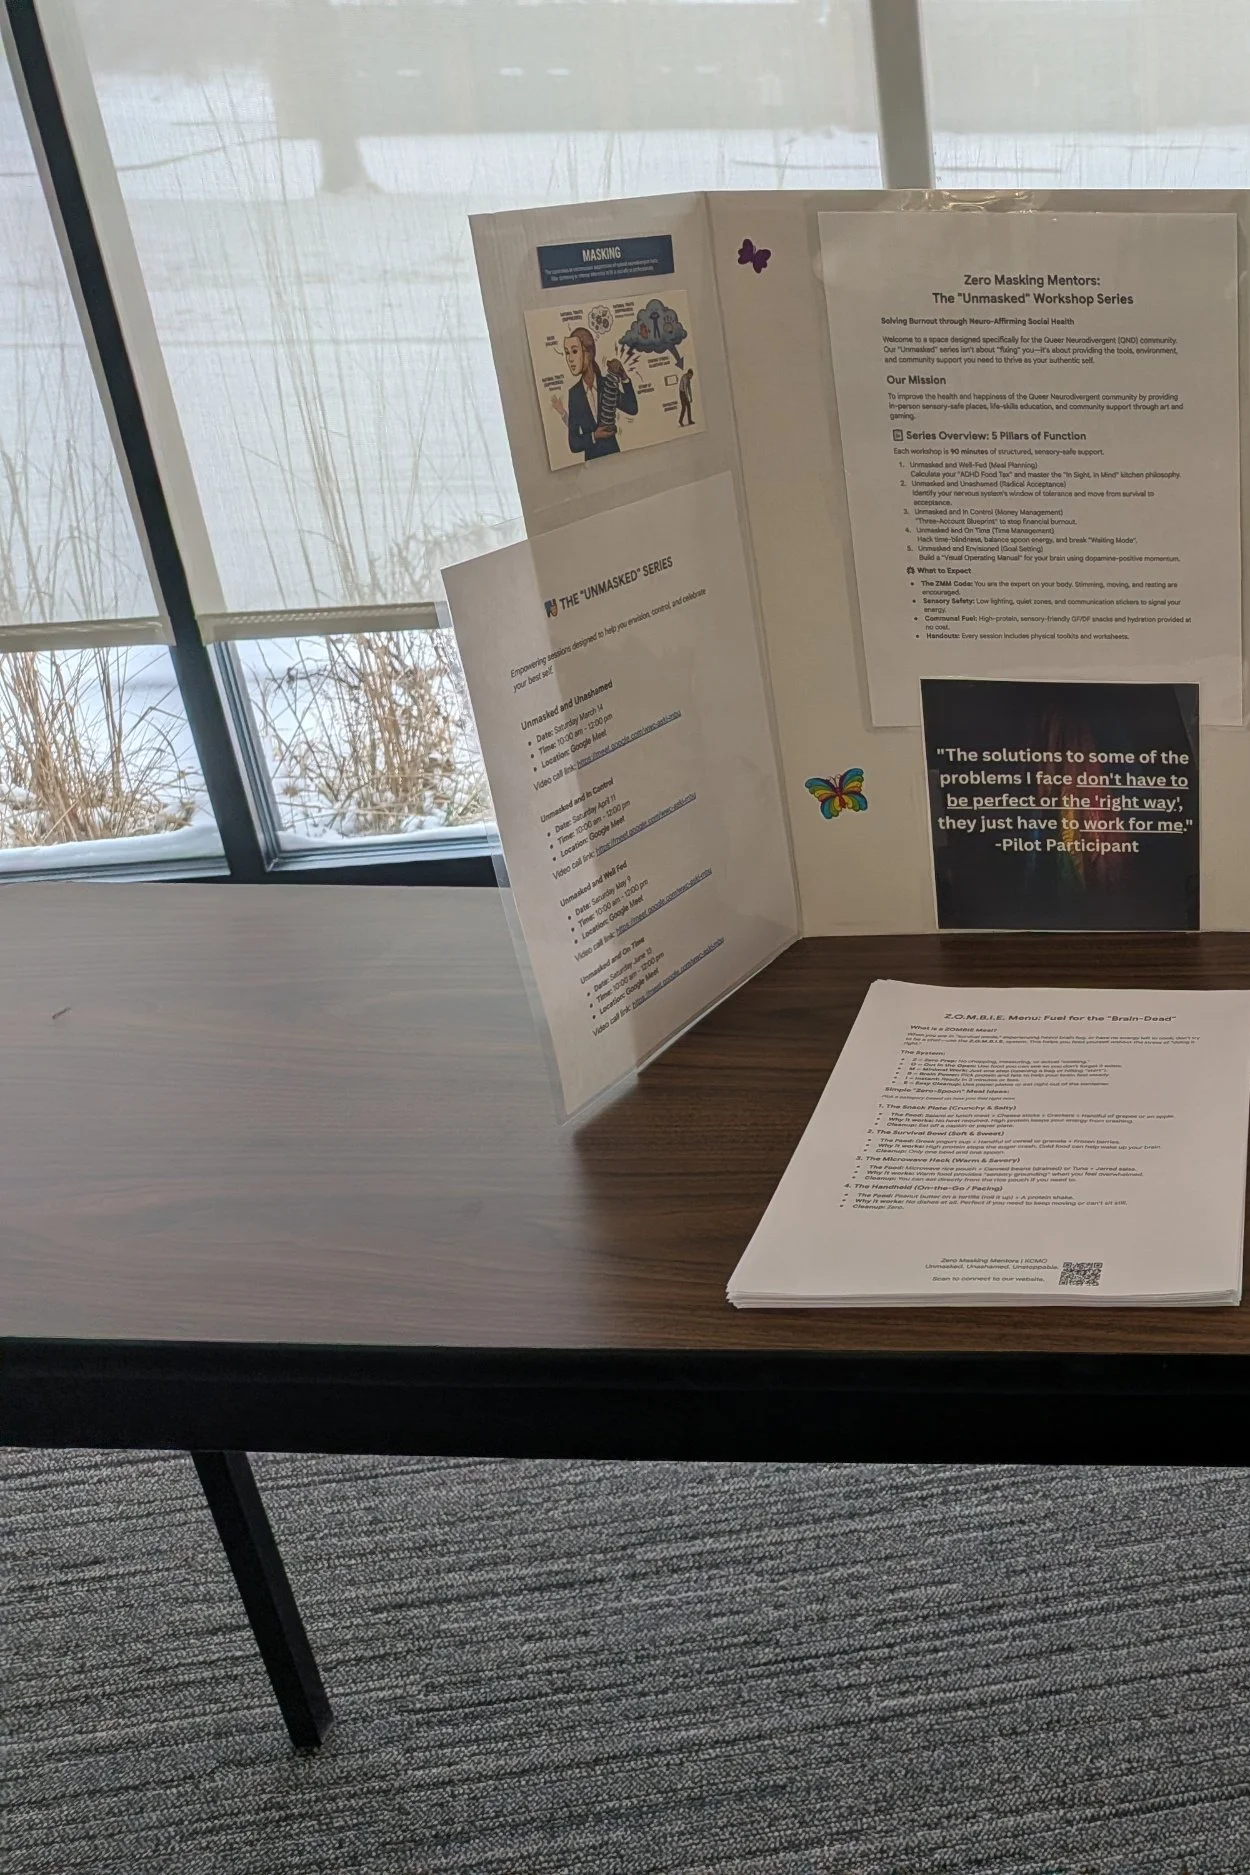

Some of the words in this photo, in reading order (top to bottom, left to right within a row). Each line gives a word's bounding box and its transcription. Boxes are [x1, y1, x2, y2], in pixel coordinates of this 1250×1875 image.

[582, 247, 621, 262] MASKING
[963, 274, 992, 286] Zero
[994, 273, 1045, 289] Masking
[1047, 274, 1101, 286] Mentors:
[931, 292, 955, 304] The
[957, 292, 1031, 304] "Unmasked"
[1032, 292, 1094, 307] Workshop
[1096, 292, 1134, 305] Series
[880, 316, 908, 326] Solving
[908, 317, 938, 325] Burnout
[938, 317, 968, 327] through
[968, 317, 1027, 327] Neuro-Affirming
[1027, 316, 1050, 325] Social
[1050, 317, 1075, 325] Health
[886, 374, 907, 385] Our
[907, 374, 947, 385] Mission
[906, 430, 937, 440] Series
[938, 430, 990, 441] Overview:
[991, 431, 998, 441] 5
[999, 431, 1030, 440] Pillars
[1030, 430, 1042, 441] of
[1043, 430, 1087, 441] Function
[916, 566, 937, 574] What
[946, 567, 972, 576] Expect
[558, 592, 580, 610] THE
[579, 567, 641, 600] "UNMASKED"
[642, 555, 673, 577] SERIES
[520, 704, 560, 731] Unmasked
[559, 697, 574, 713] and
[573, 679, 613, 705] Unashamed
[535, 729, 554, 744] Date:
[553, 716, 579, 735] Saturday
[578, 707, 597, 721] March
[596, 703, 604, 712] 14
[540, 748, 570, 769] Location:
[570, 737, 592, 754] Google
[591, 728, 608, 742] Meet
[937, 748, 977, 761] "The
[983, 748, 1061, 762] solutions
[1066, 750, 1084, 762] to
[1089, 752, 1134, 763] some
[1140, 750, 1156, 764] of
[1161, 750, 1189, 764] the
[940, 770, 1021, 787] problems
[1027, 772, 1031, 784] I
[1036, 771, 1072, 784] face
[1076, 771, 1122, 786] don't
[1126, 774, 1166, 786] have
[1170, 775, 1188, 787] to
[540, 799, 574, 823] Unmasked
[573, 792, 586, 806] and
[592, 776, 614, 795] Control
[947, 794, 968, 807] be
[973, 794, 1036, 809] perfect
[1040, 796, 1058, 808] or
[1062, 795, 1090, 808] the
[1096, 795, 1140, 811] 'right
[938, 816, 976, 832] they
[980, 817, 1012, 832] just
[1017, 817, 1056, 829] have
[1061, 818, 1079, 830] to
[1084, 817, 1124, 830] work
[1129, 818, 1153, 830] for
[1158, 820, 1192, 832] me."
[995, 838, 1041, 851] -Pilot
[1046, 838, 1138, 855] Participant
[559, 881, 592, 907] Unmasked
[591, 874, 604, 888] and
[602, 866, 617, 880] Well
[615, 859, 628, 873] Fed
[580, 958, 611, 985] Unmasked
[611, 950, 622, 964] and
[621, 946, 632, 956] On
[630, 936, 645, 950] Time
[943, 1013, 1005, 1021] Z.O.M.B.I.E.
[1107, 1015, 1177, 1024] "Brain-Dead"
